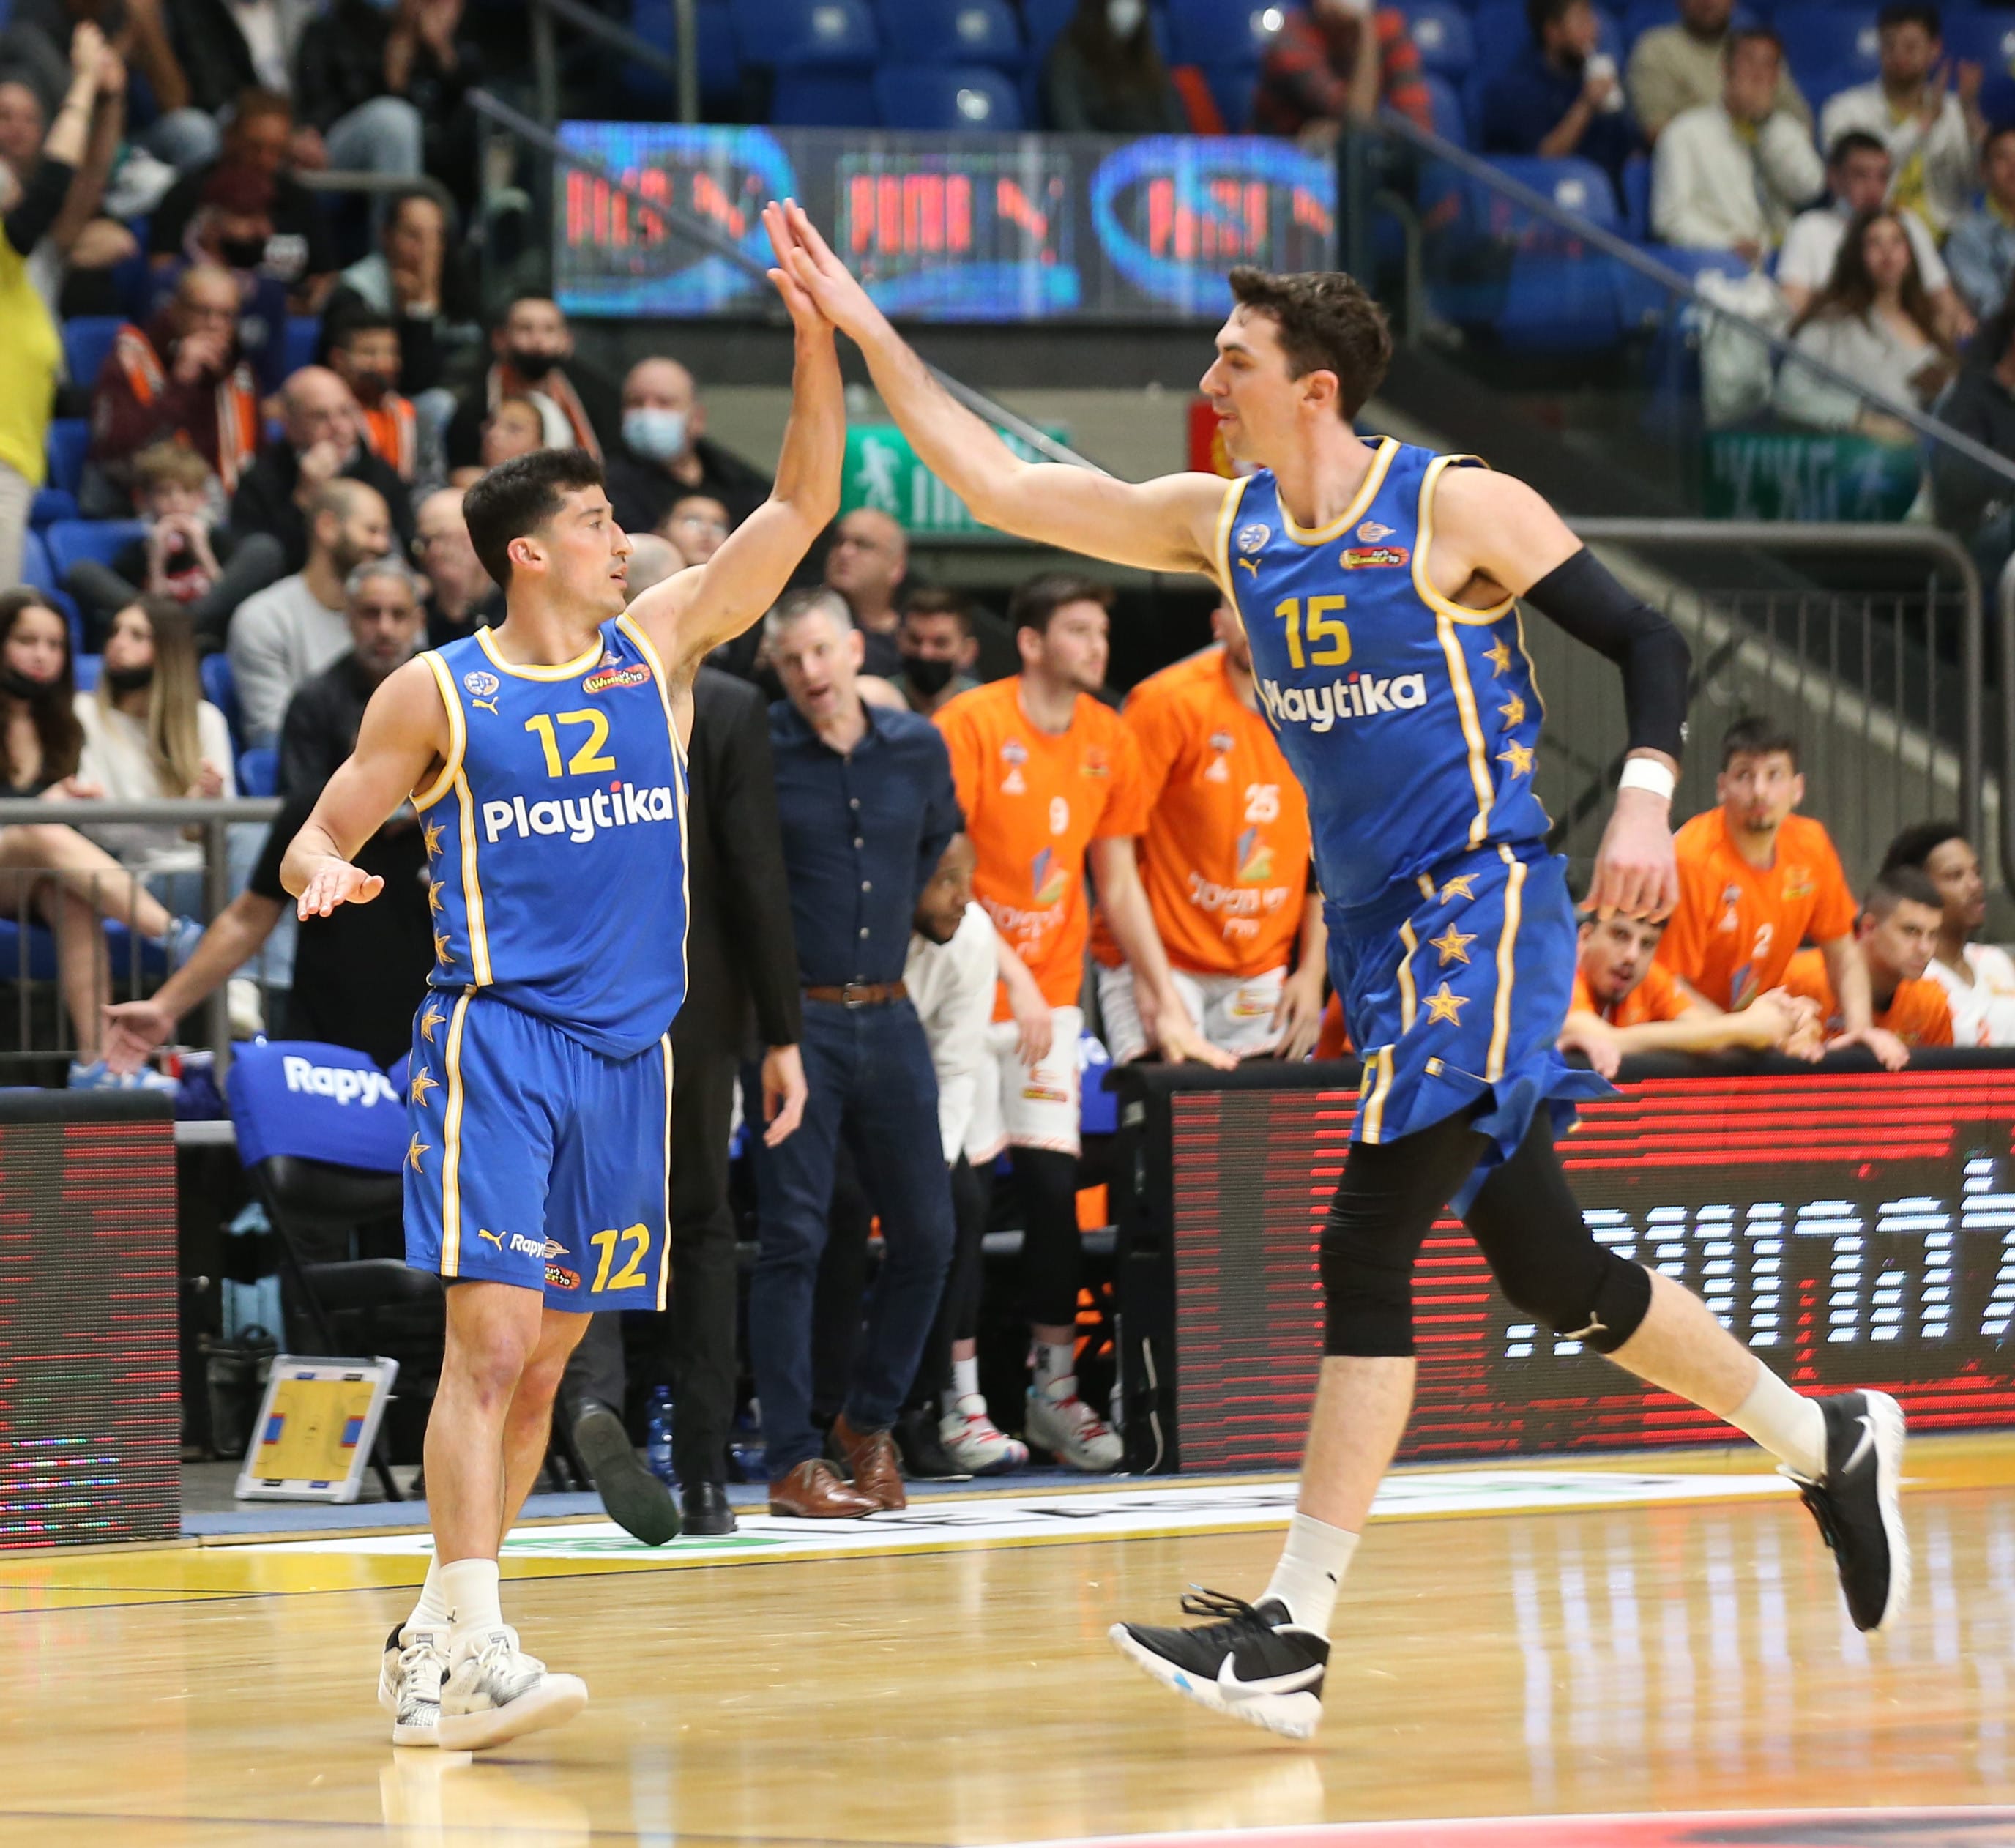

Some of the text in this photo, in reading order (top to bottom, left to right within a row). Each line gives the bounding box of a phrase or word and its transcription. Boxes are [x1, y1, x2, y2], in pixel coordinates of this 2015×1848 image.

[1275, 595, 1352, 669] 15
[524, 708, 616, 778] 12
[482, 780, 674, 843] Playtika
[1245, 783, 1280, 823] 25
[1751, 923, 1773, 959] 2
[590, 1222, 650, 1292] 12
